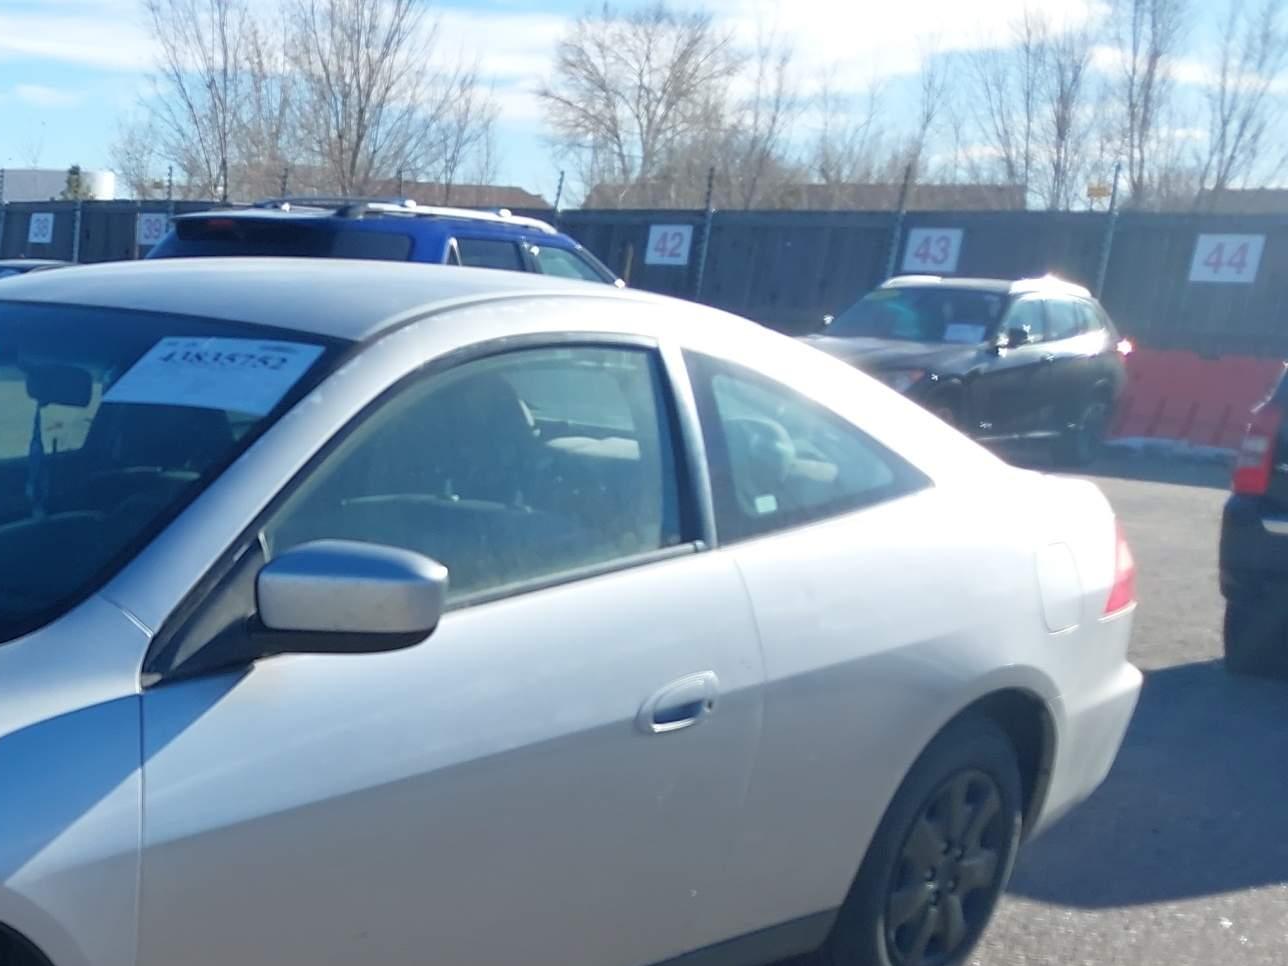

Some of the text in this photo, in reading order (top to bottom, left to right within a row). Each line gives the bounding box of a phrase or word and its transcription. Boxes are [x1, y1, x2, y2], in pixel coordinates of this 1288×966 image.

[654, 231, 684, 257] 42
[914, 235, 951, 265] 43
[1203, 242, 1249, 275] 44
